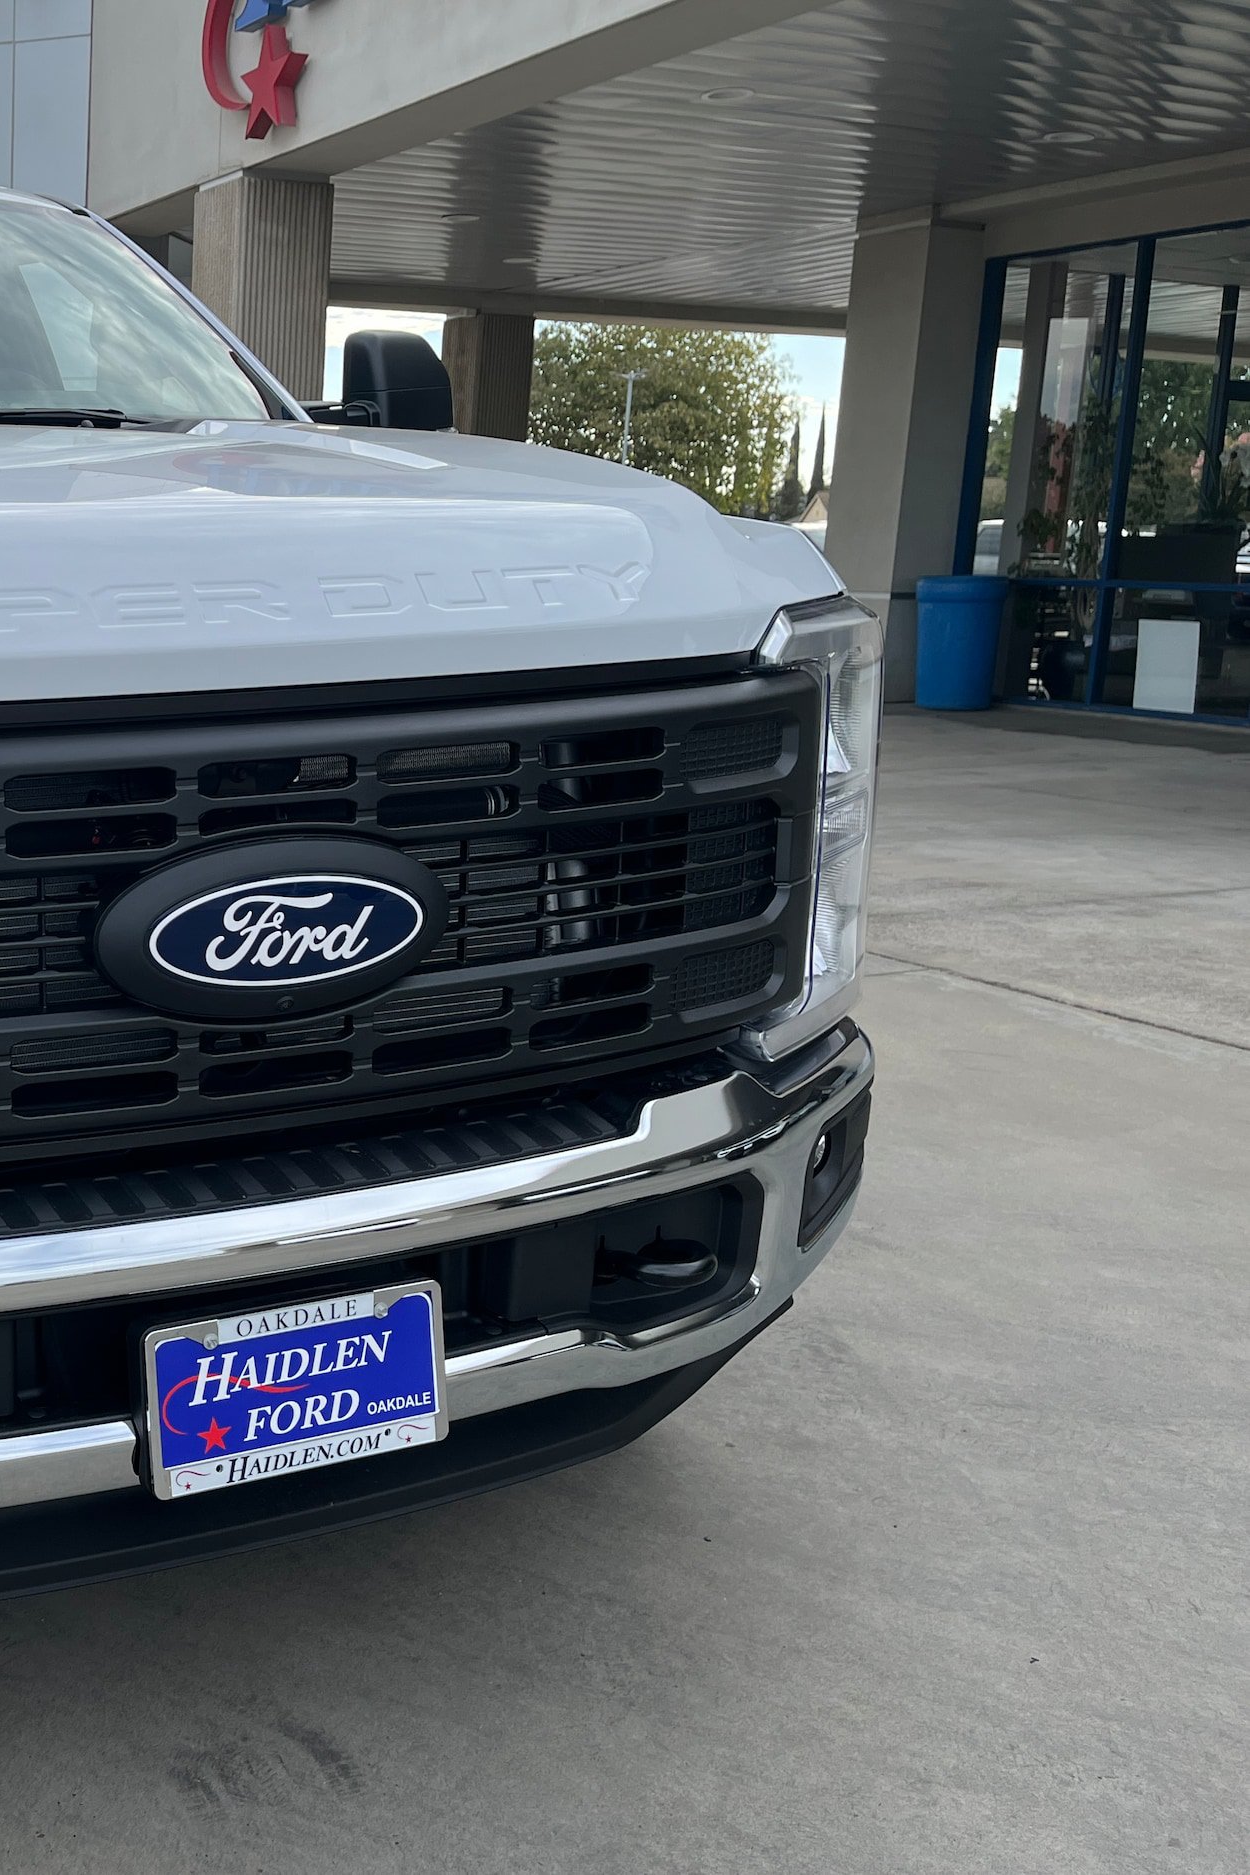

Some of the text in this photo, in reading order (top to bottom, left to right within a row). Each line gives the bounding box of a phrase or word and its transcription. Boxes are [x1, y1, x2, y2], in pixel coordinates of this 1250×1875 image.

[317, 561, 649, 618] DUTY
[205, 892, 375, 972] Ford
[236, 1299, 358, 1338] OAKDALE
[188, 1331, 392, 1408] HAIDLEN
[243, 1388, 361, 1443] FORD
[366, 1391, 432, 1417] OAKDALE
[226, 1432, 383, 1485] HAIDLEN.COM
